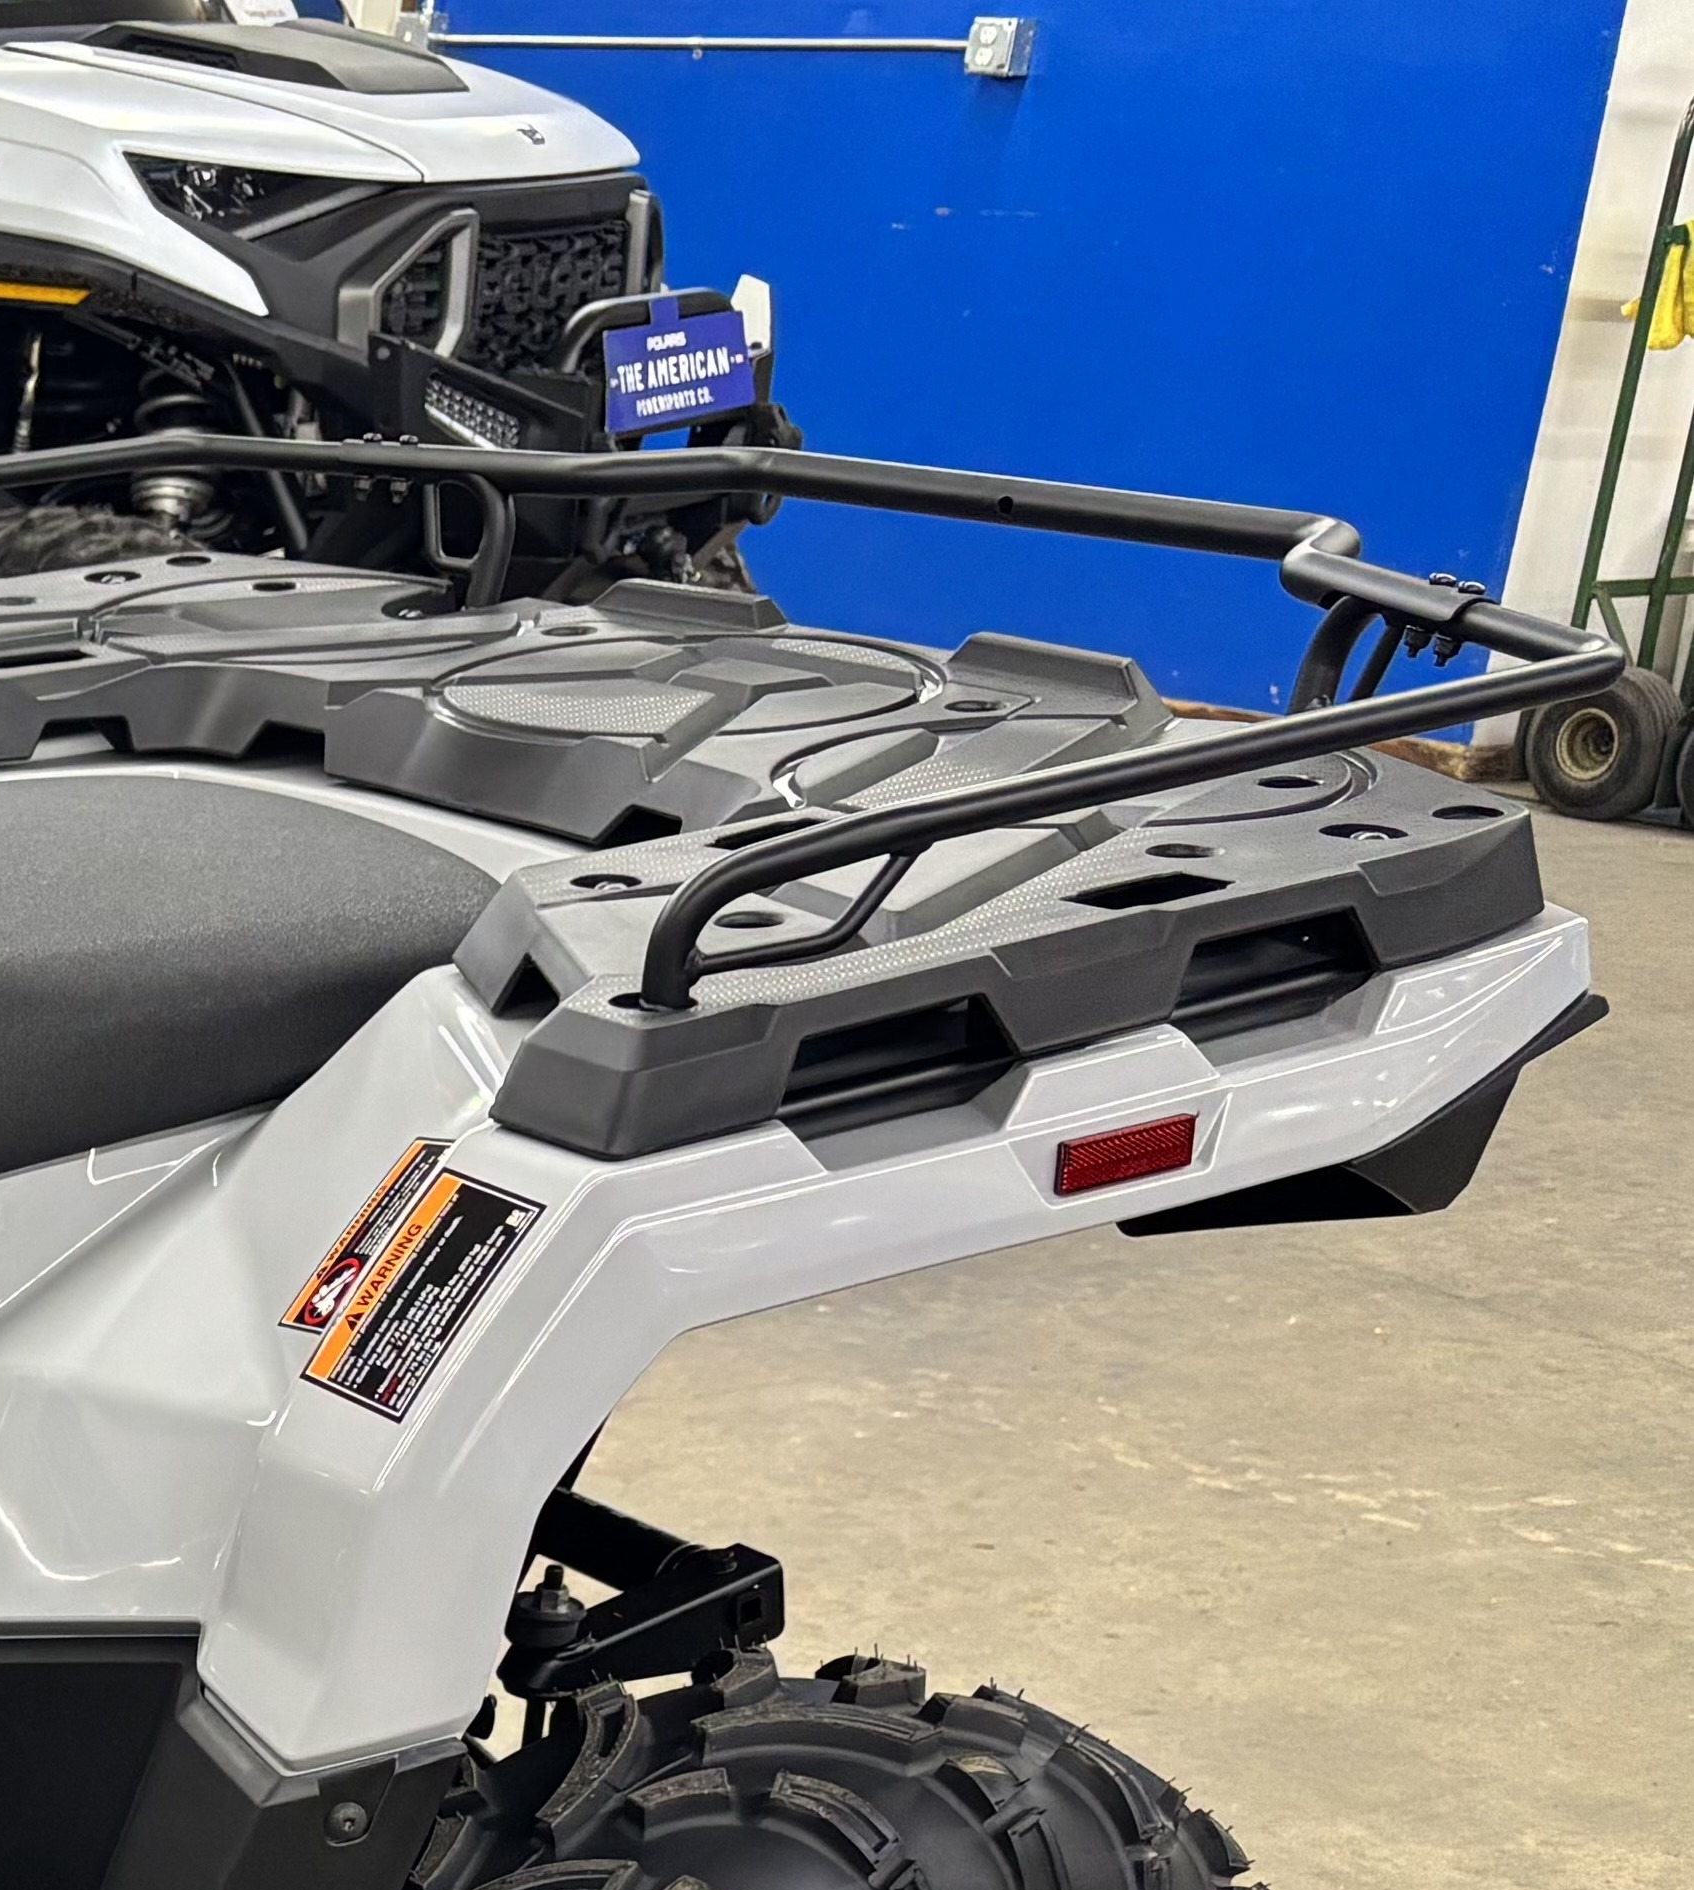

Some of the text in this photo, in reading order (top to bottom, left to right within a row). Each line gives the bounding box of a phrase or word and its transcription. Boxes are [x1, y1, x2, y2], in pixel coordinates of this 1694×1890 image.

[617, 346, 730, 394] THE AMERICAN
[329, 1184, 389, 1262] WARNING
[357, 1223, 424, 1307] WARNING
